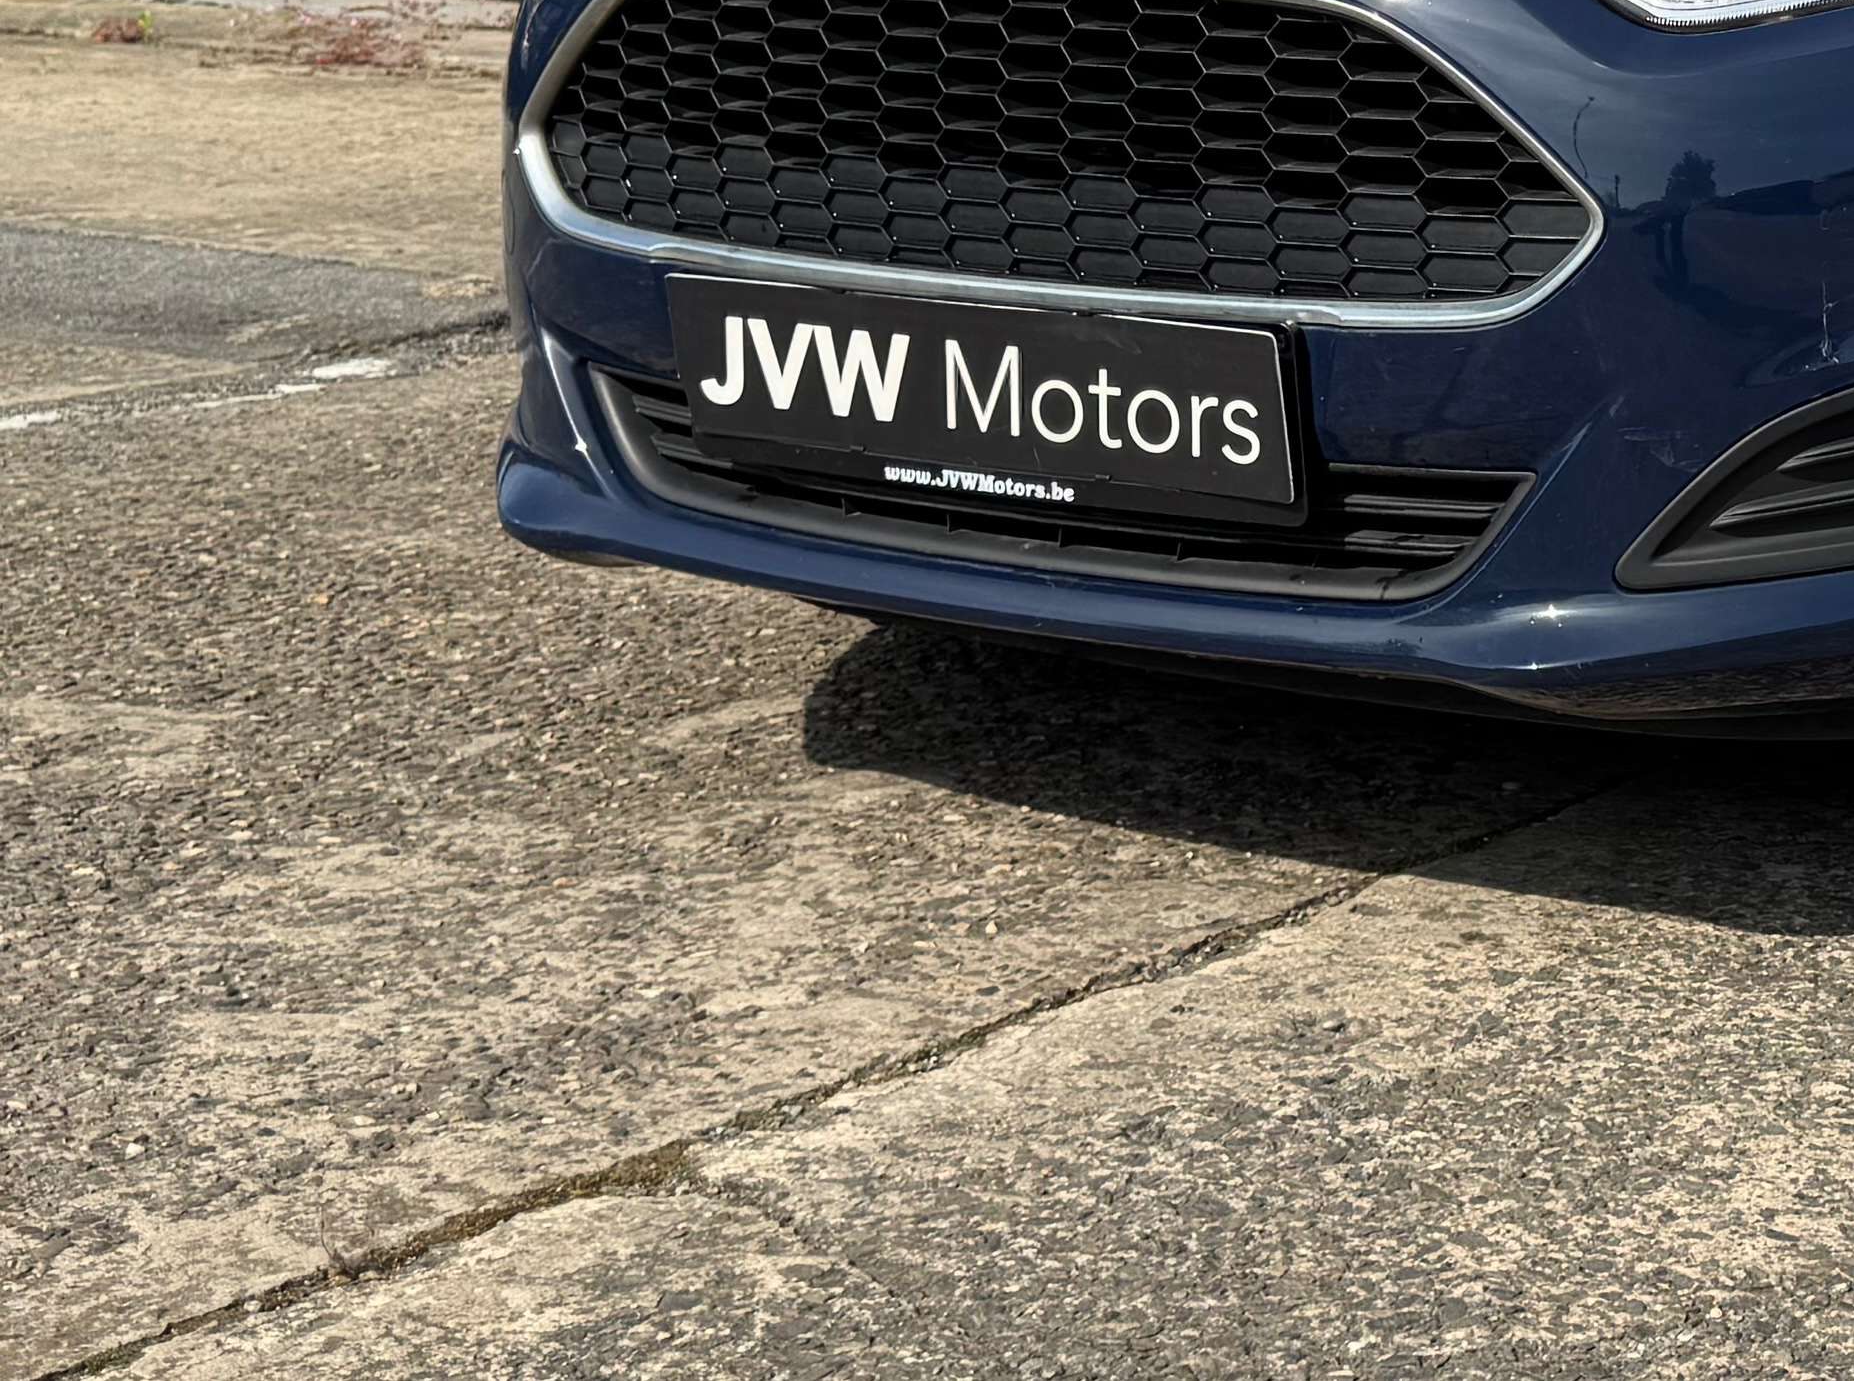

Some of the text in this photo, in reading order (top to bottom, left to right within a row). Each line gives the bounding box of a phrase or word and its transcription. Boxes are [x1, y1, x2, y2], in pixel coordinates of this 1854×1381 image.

[699, 315, 1261, 465] JVW Motors
[883, 466, 1075, 503] www.JVWMotors.be
